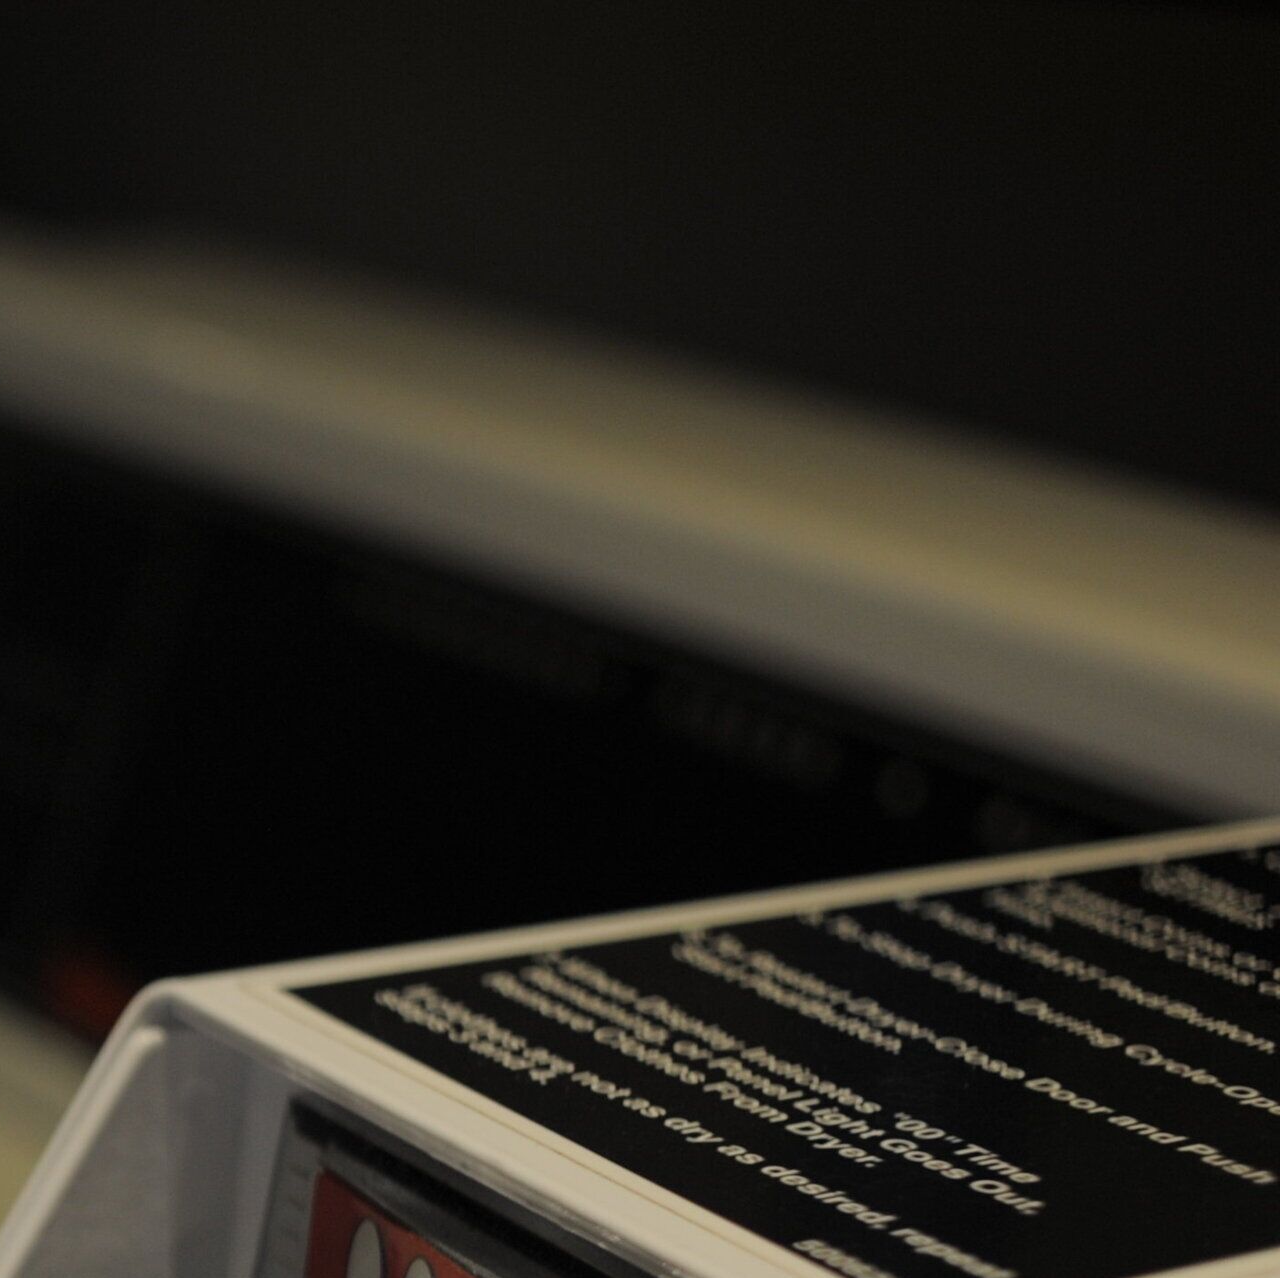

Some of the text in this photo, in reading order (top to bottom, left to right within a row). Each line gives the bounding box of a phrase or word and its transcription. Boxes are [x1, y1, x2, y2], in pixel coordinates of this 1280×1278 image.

[570, 1070, 631, 1099] not
[623, 1098, 667, 1118] as
[663, 1116, 724, 1143] dry
[716, 1144, 765, 1165] as
[760, 1163, 898, 1230] desired,
[702, 1080, 789, 1123] From
[784, 1120, 884, 1168] Dryer.
[707, 1055, 803, 1101] Panel
[792, 1098, 886, 1139] Light
[879, 1137, 973, 1180] Goes
[740, 1046, 883, 1114] Indicates
[954, 1144, 1042, 1184] Time
[1024, 1077, 1115, 1115] Door
[1108, 1115, 1189, 1144] and
[1177, 1143, 1277, 1185] Push
